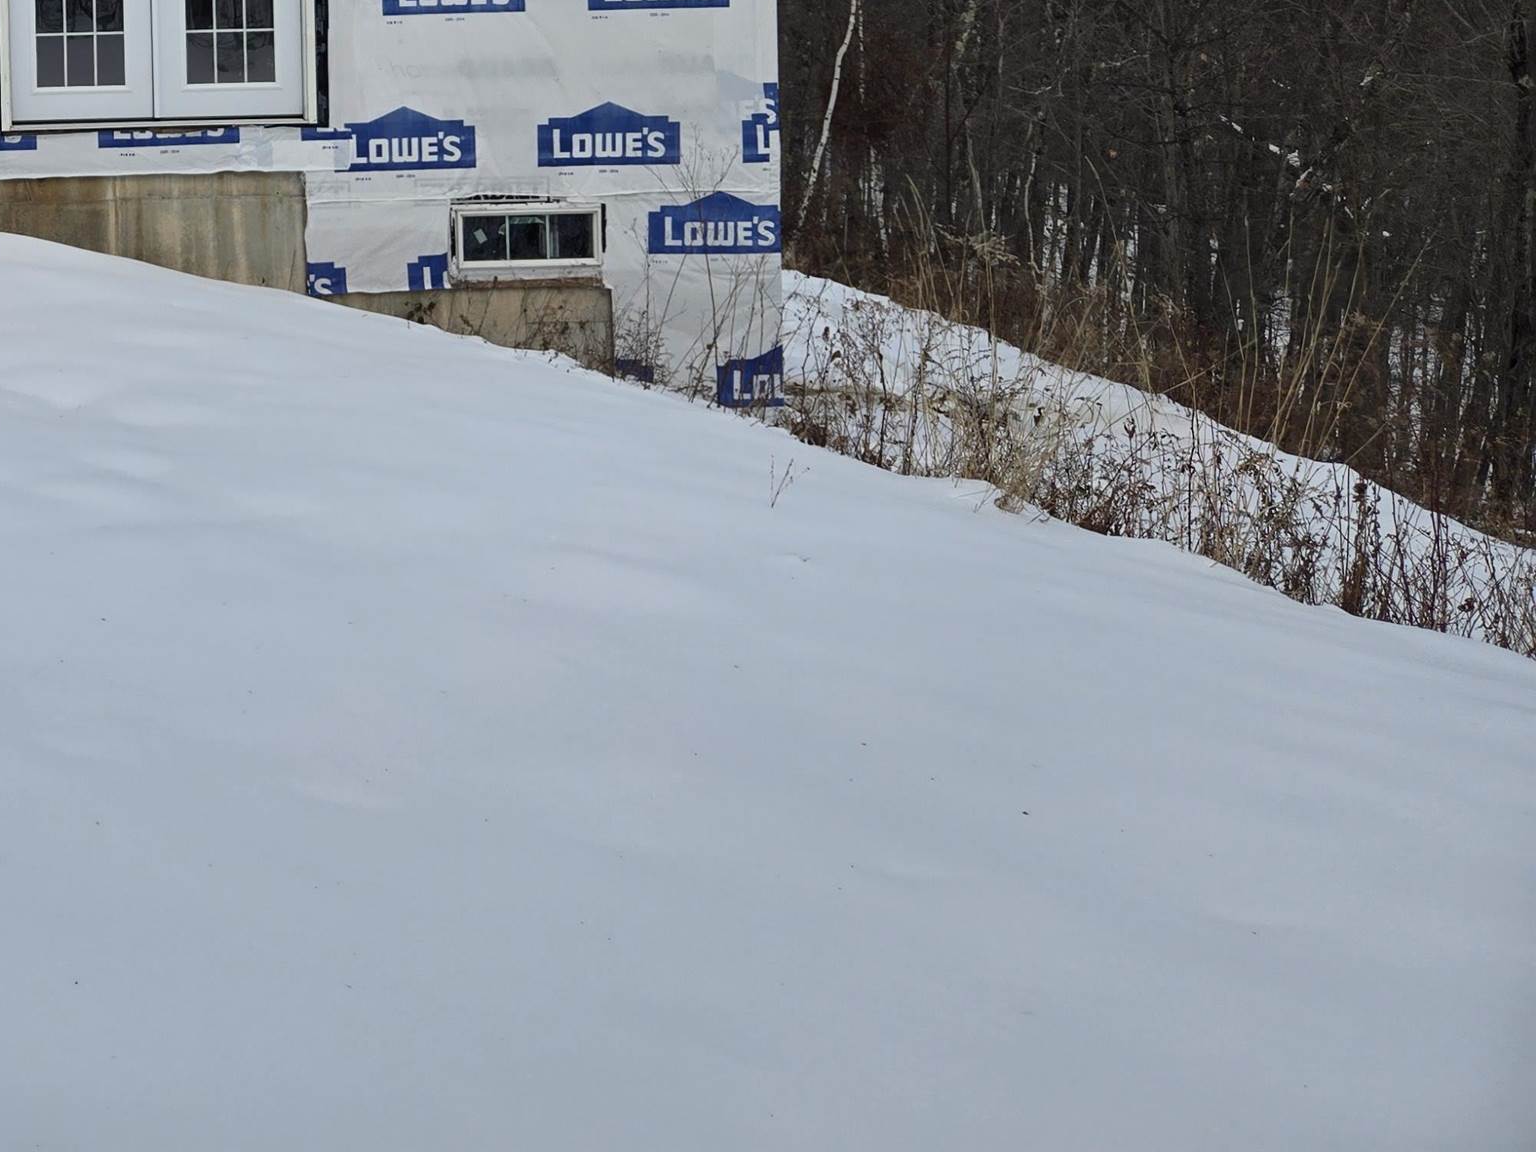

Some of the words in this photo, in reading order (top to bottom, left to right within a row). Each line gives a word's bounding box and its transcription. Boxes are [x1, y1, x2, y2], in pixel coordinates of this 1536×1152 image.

[351, 131, 462, 164] LOWE'S
[552, 127, 666, 159] LOWE'S
[664, 216, 776, 247] LOWE'S
